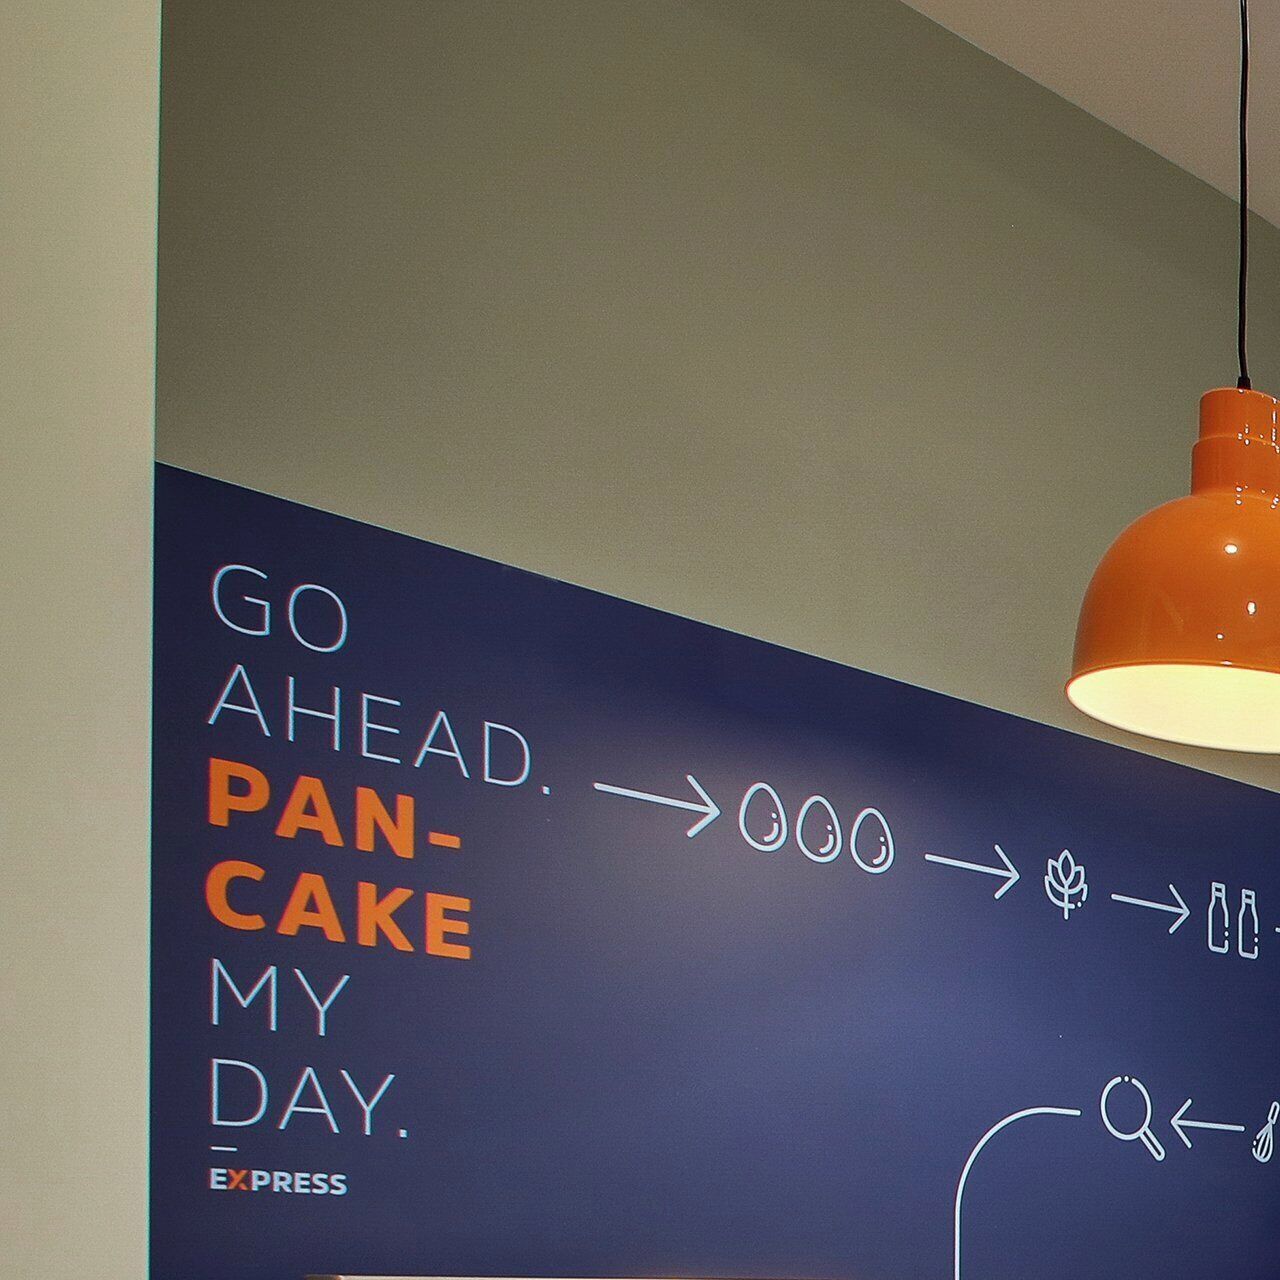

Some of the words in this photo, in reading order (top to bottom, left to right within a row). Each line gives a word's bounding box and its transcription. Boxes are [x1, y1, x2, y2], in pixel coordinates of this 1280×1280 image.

[211, 563, 349, 653] GO
[207, 664, 551, 796] AHEAD.
[208, 756, 461, 859] PAN-
[205, 860, 472, 960] CAKE
[210, 957, 350, 1037] MY
[210, 1057, 408, 1139] DAY.
[209, 1166, 348, 1197] EXPRESS
